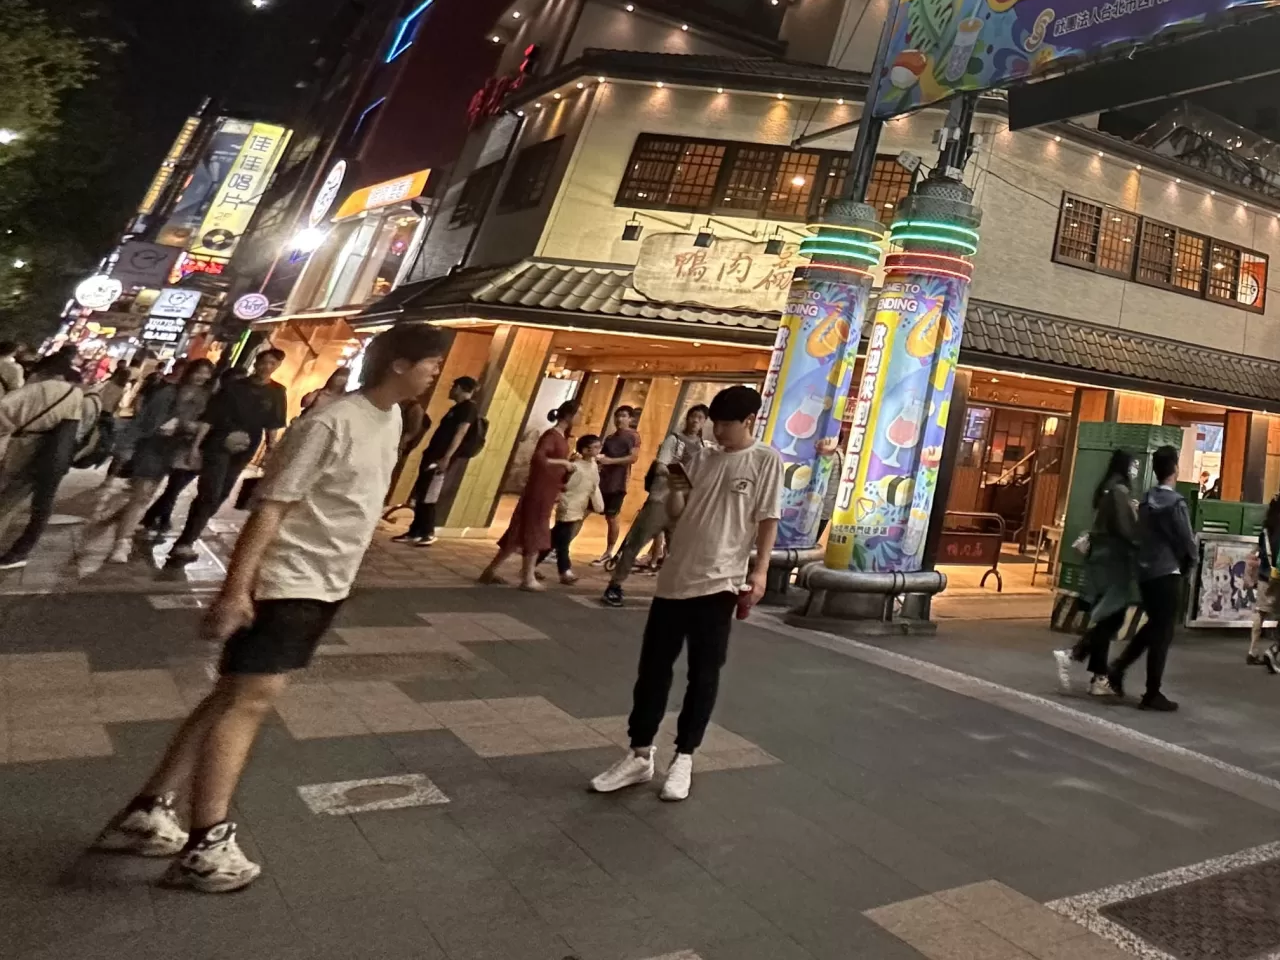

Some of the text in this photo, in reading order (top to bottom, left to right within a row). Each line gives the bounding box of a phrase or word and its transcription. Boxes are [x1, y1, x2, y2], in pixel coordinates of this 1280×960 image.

[217, 135, 274, 211] 佳佳唱片
[806, 290, 821, 300] TO
[904, 283, 921, 295] TO
